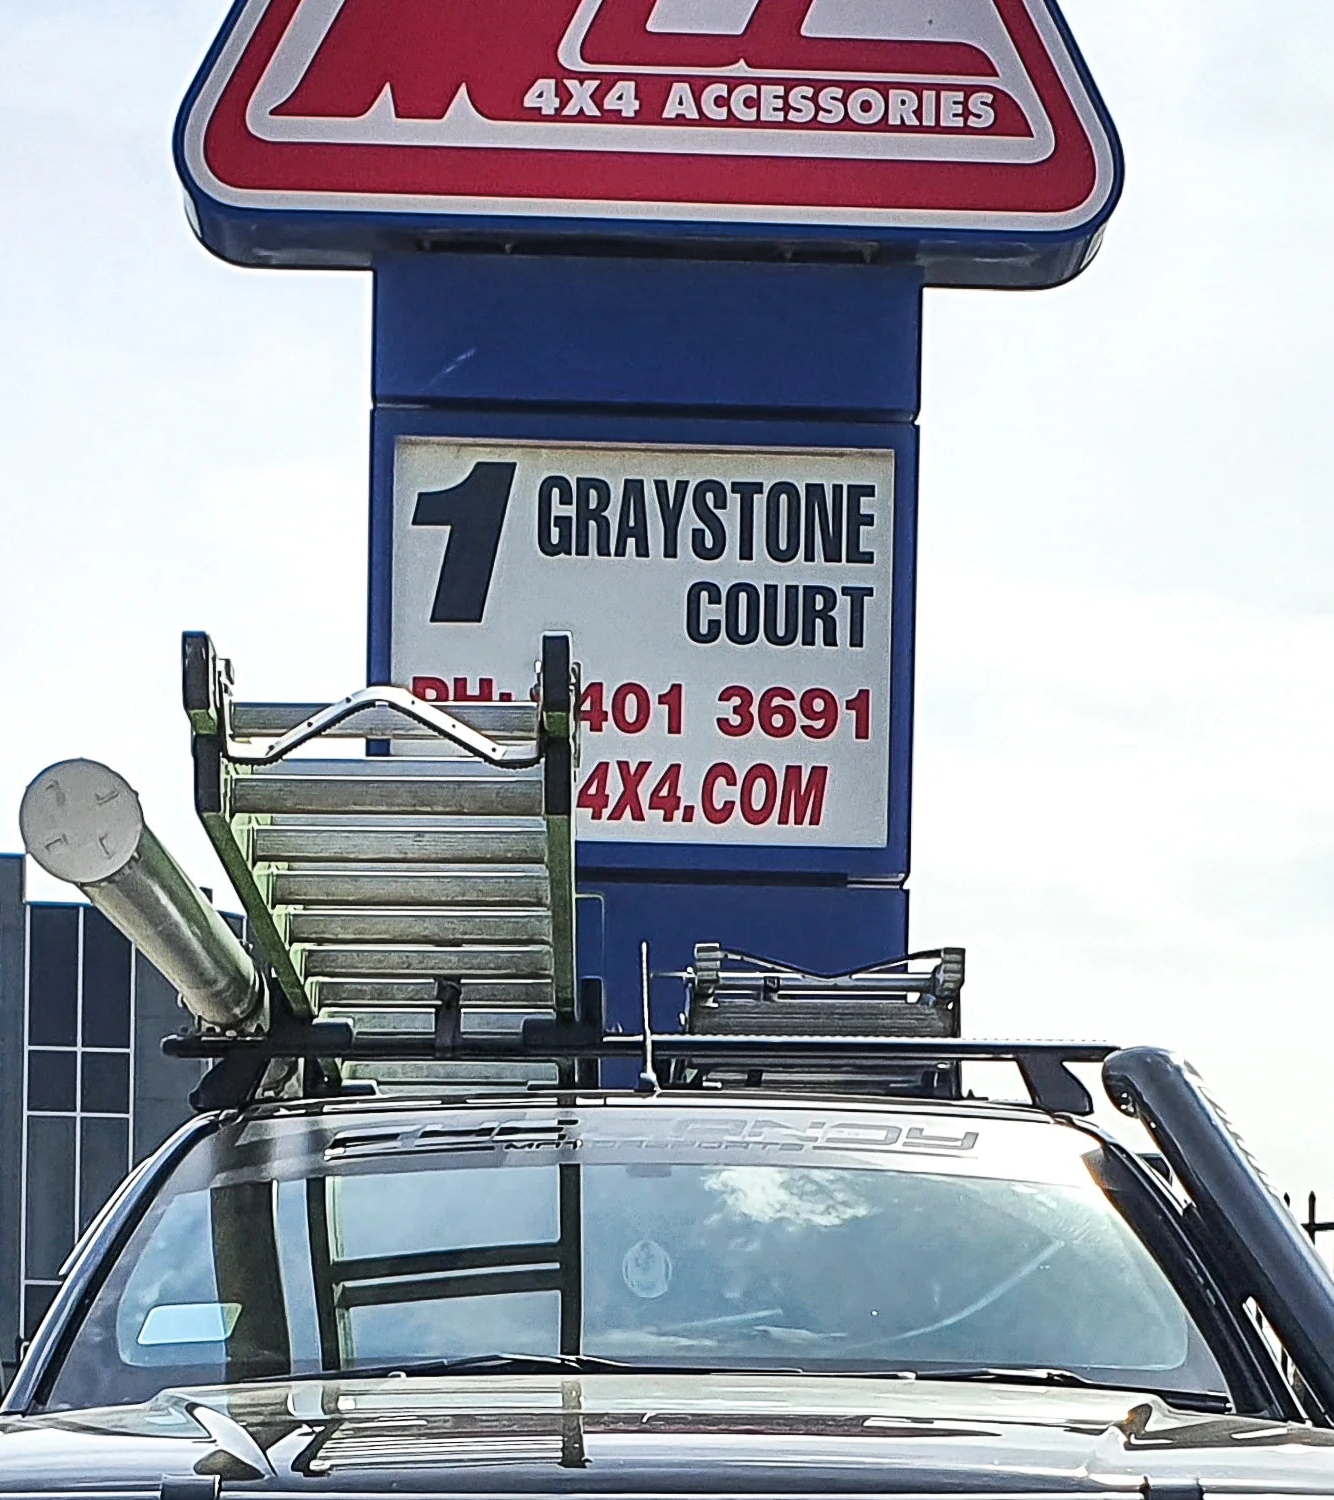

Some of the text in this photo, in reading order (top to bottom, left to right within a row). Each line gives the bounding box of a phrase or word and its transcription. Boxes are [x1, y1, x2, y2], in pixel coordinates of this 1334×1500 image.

[523, 79, 996, 128] 4X4 ACCESSORIES
[410, 461, 876, 623] 1 GRAYSTONE
[685, 581, 875, 648] COURT
[530, 681, 684, 735] 401
[716, 685, 871, 741] 3691
